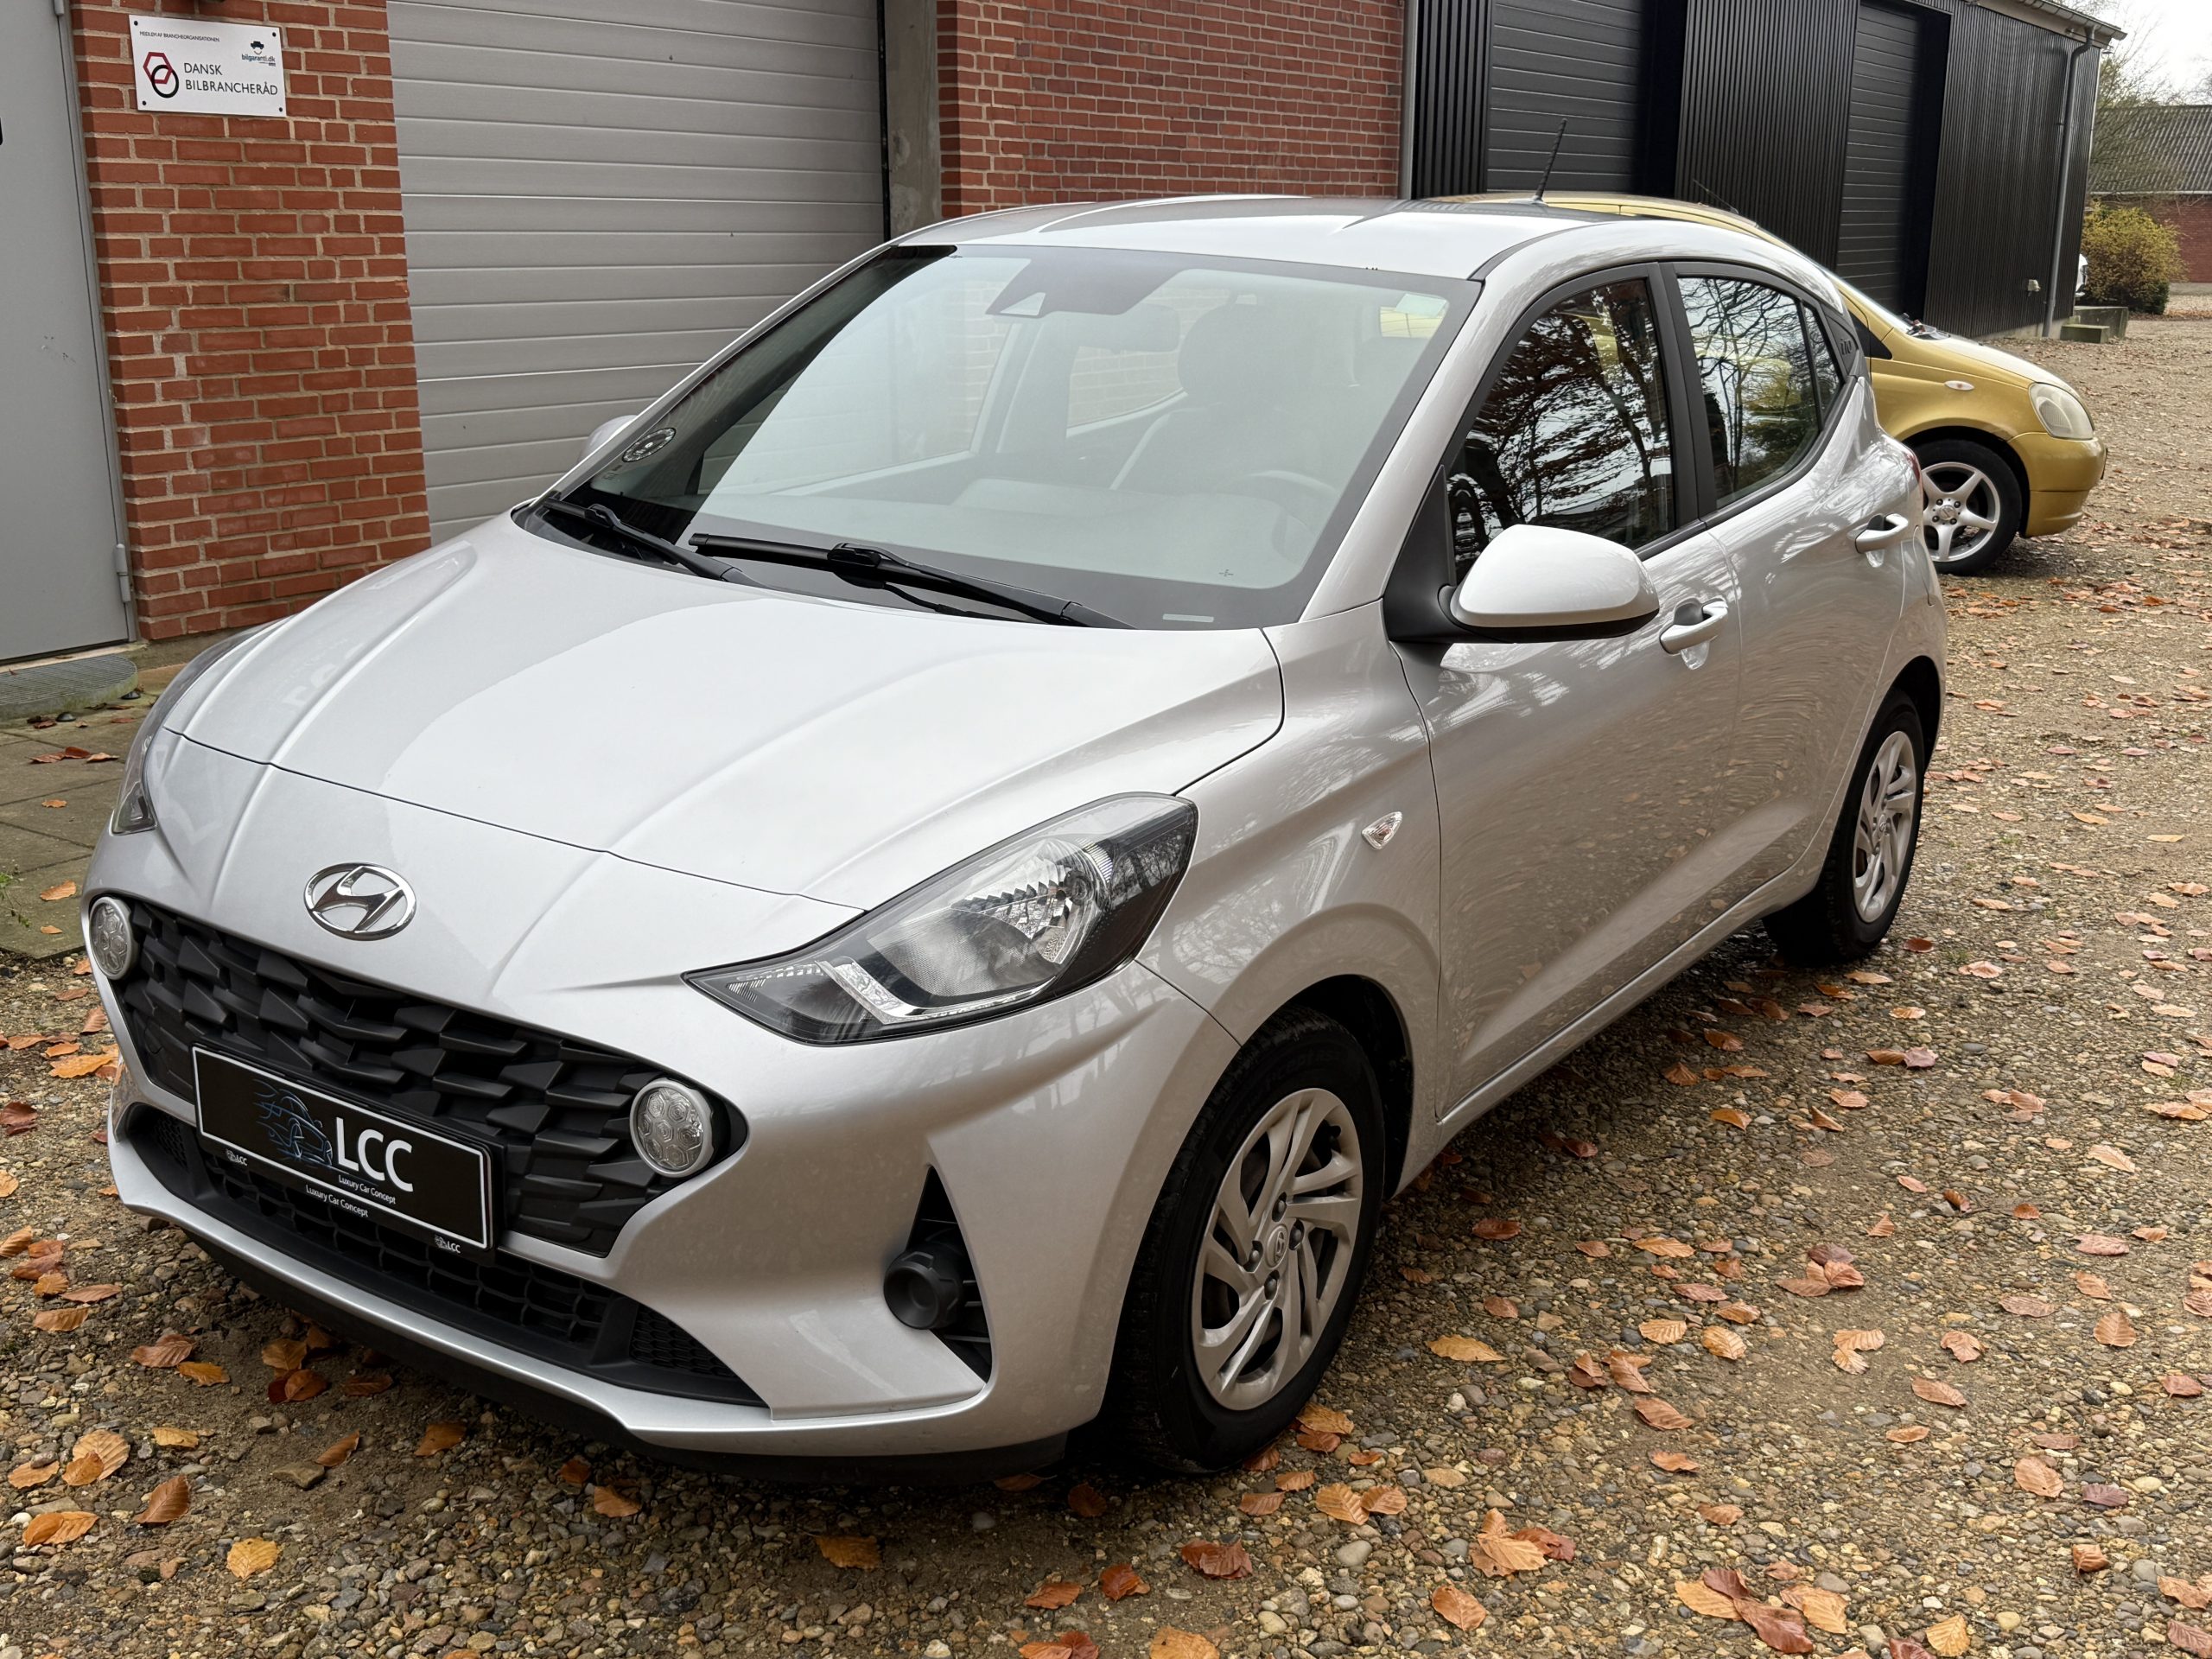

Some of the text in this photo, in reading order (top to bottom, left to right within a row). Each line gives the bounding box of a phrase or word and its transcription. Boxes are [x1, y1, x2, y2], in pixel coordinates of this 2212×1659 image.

[241, 54, 276, 62] bilgaranti.dk
[184, 62, 223, 75] DANSK
[185, 79, 278, 95] BILBRANCHERÅD
[236, 1154, 248, 1166] LCC
[335, 1116, 414, 1192] LCC
[338, 1174, 397, 1205] Luxury Car Concept
[305, 1185, 369, 1217] Luxury Car Concept
[447, 1240, 461, 1254] LCC
